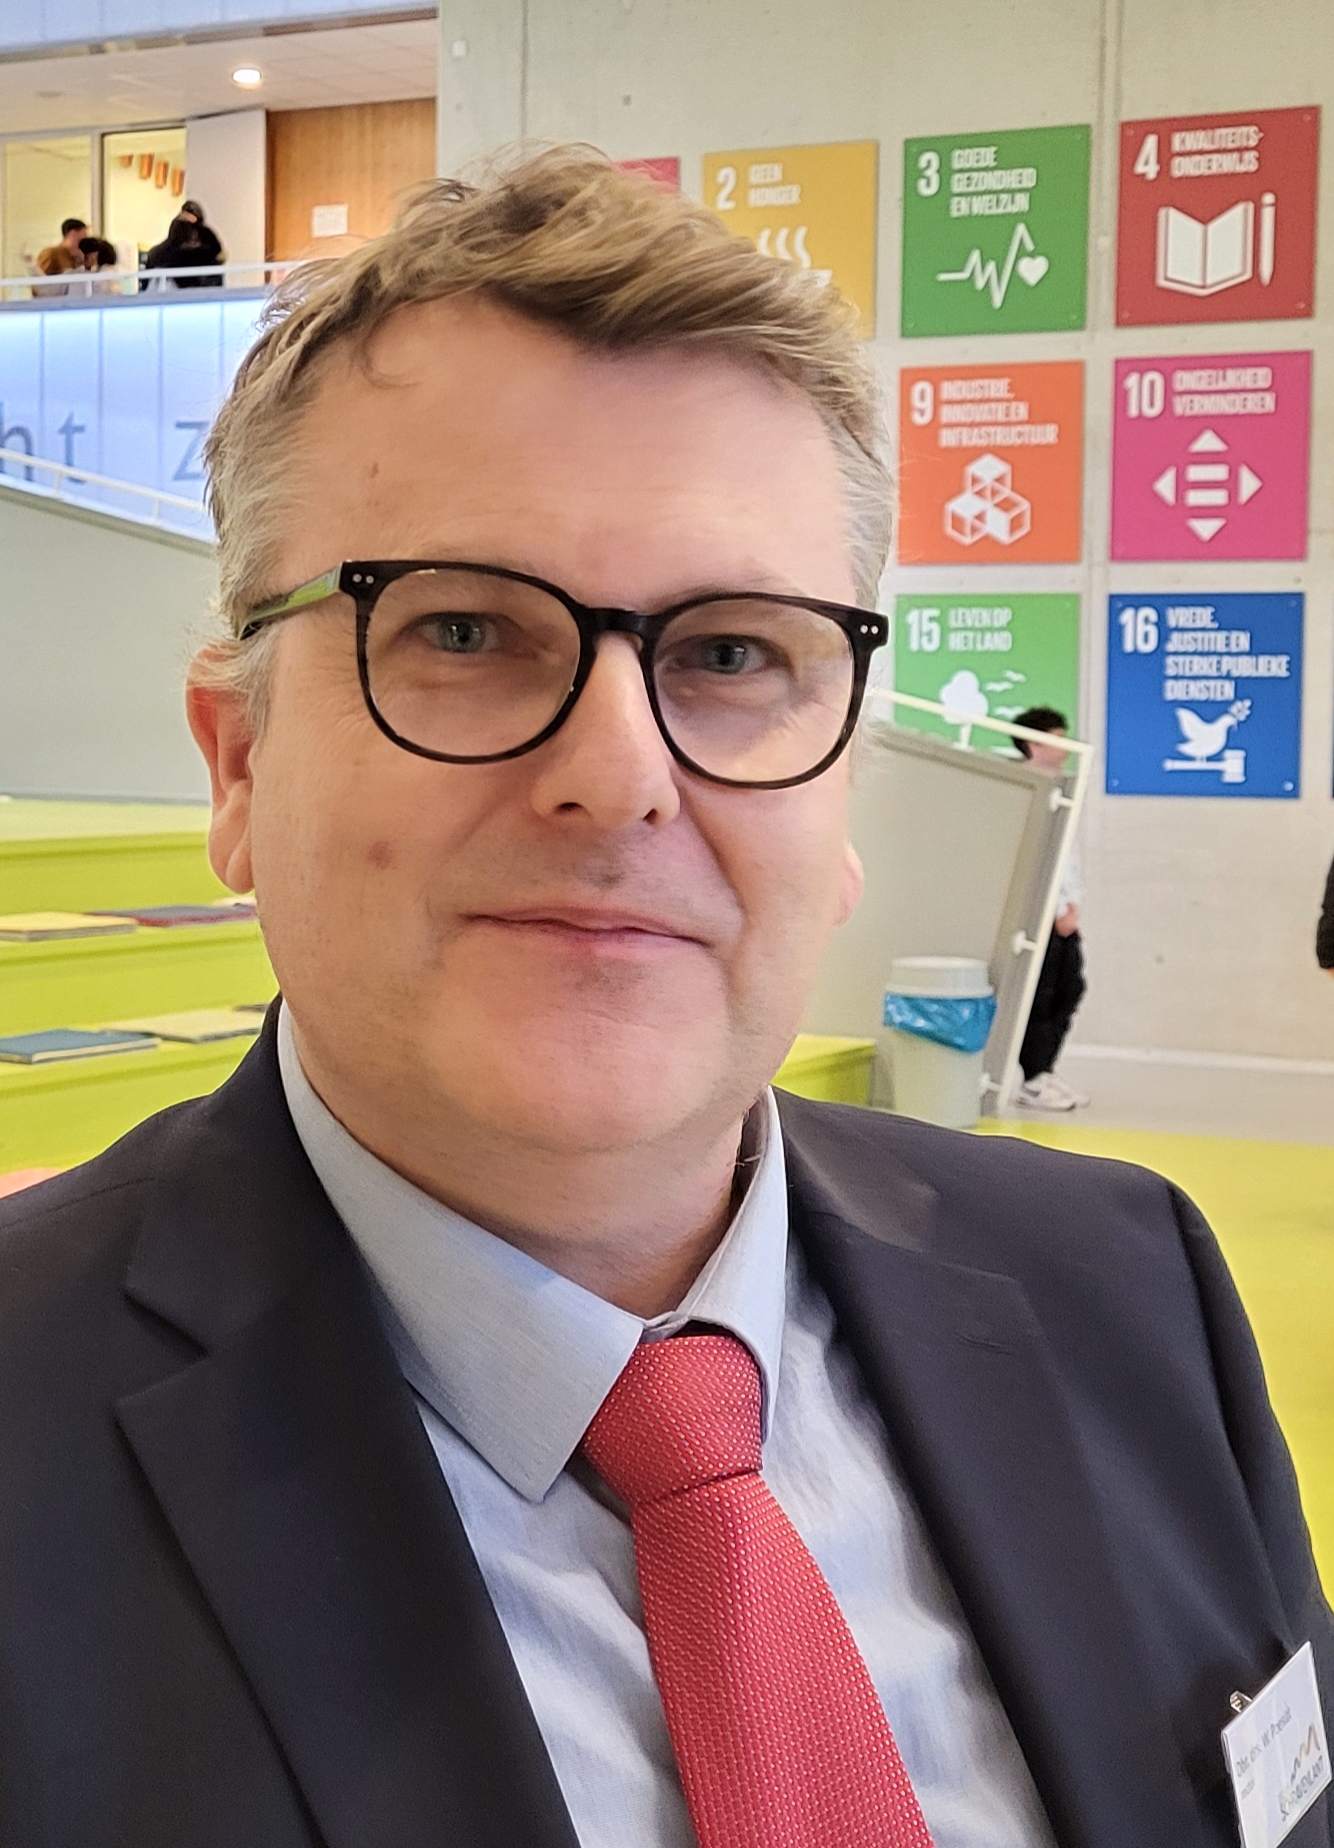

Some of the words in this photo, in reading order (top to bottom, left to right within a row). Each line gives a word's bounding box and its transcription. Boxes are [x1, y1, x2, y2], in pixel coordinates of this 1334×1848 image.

[1171, 125, 1265, 153] KWALITEITS-
[951, 146, 998, 169] GOEDE
[1134, 133, 1160, 180] 4
[1171, 150, 1259, 178] ONDERWIJS
[748, 163, 783, 185] GEEN
[918, 151, 940, 197] 3
[950, 167, 1037, 193] GEZONDHEID
[716, 166, 737, 211] 2
[748, 184, 801, 208] HONGER
[950, 195, 970, 218] EN
[971, 192, 1030, 216] WELZIJN
[1172, 366, 1272, 392] ONGELIJKHEID
[910, 380, 934, 426] 9
[1124, 370, 1165, 418] 10
[1172, 391, 1276, 417] VERMINDEREN
[940, 401, 1013, 425] INNOVATIE
[1014, 401, 1029, 421] EN
[939, 423, 1059, 448] INFRASTRUCTUUR
[906, 607, 941, 652] 15
[948, 607, 991, 628] LEVEN
[992, 607, 1013, 628] OP
[1120, 606, 1159, 654] 16
[1165, 606, 1219, 628] VREDE,
[948, 630, 974, 651] HET
[975, 630, 1012, 651] LAND
[1165, 630, 1229, 652] JUSTITIE
[1230, 630, 1250, 652] EN
[1165, 655, 1220, 677] STERKE
[1221, 655, 1291, 677] PUBLIEKE
[1165, 679, 1235, 701] DIENSTEN
